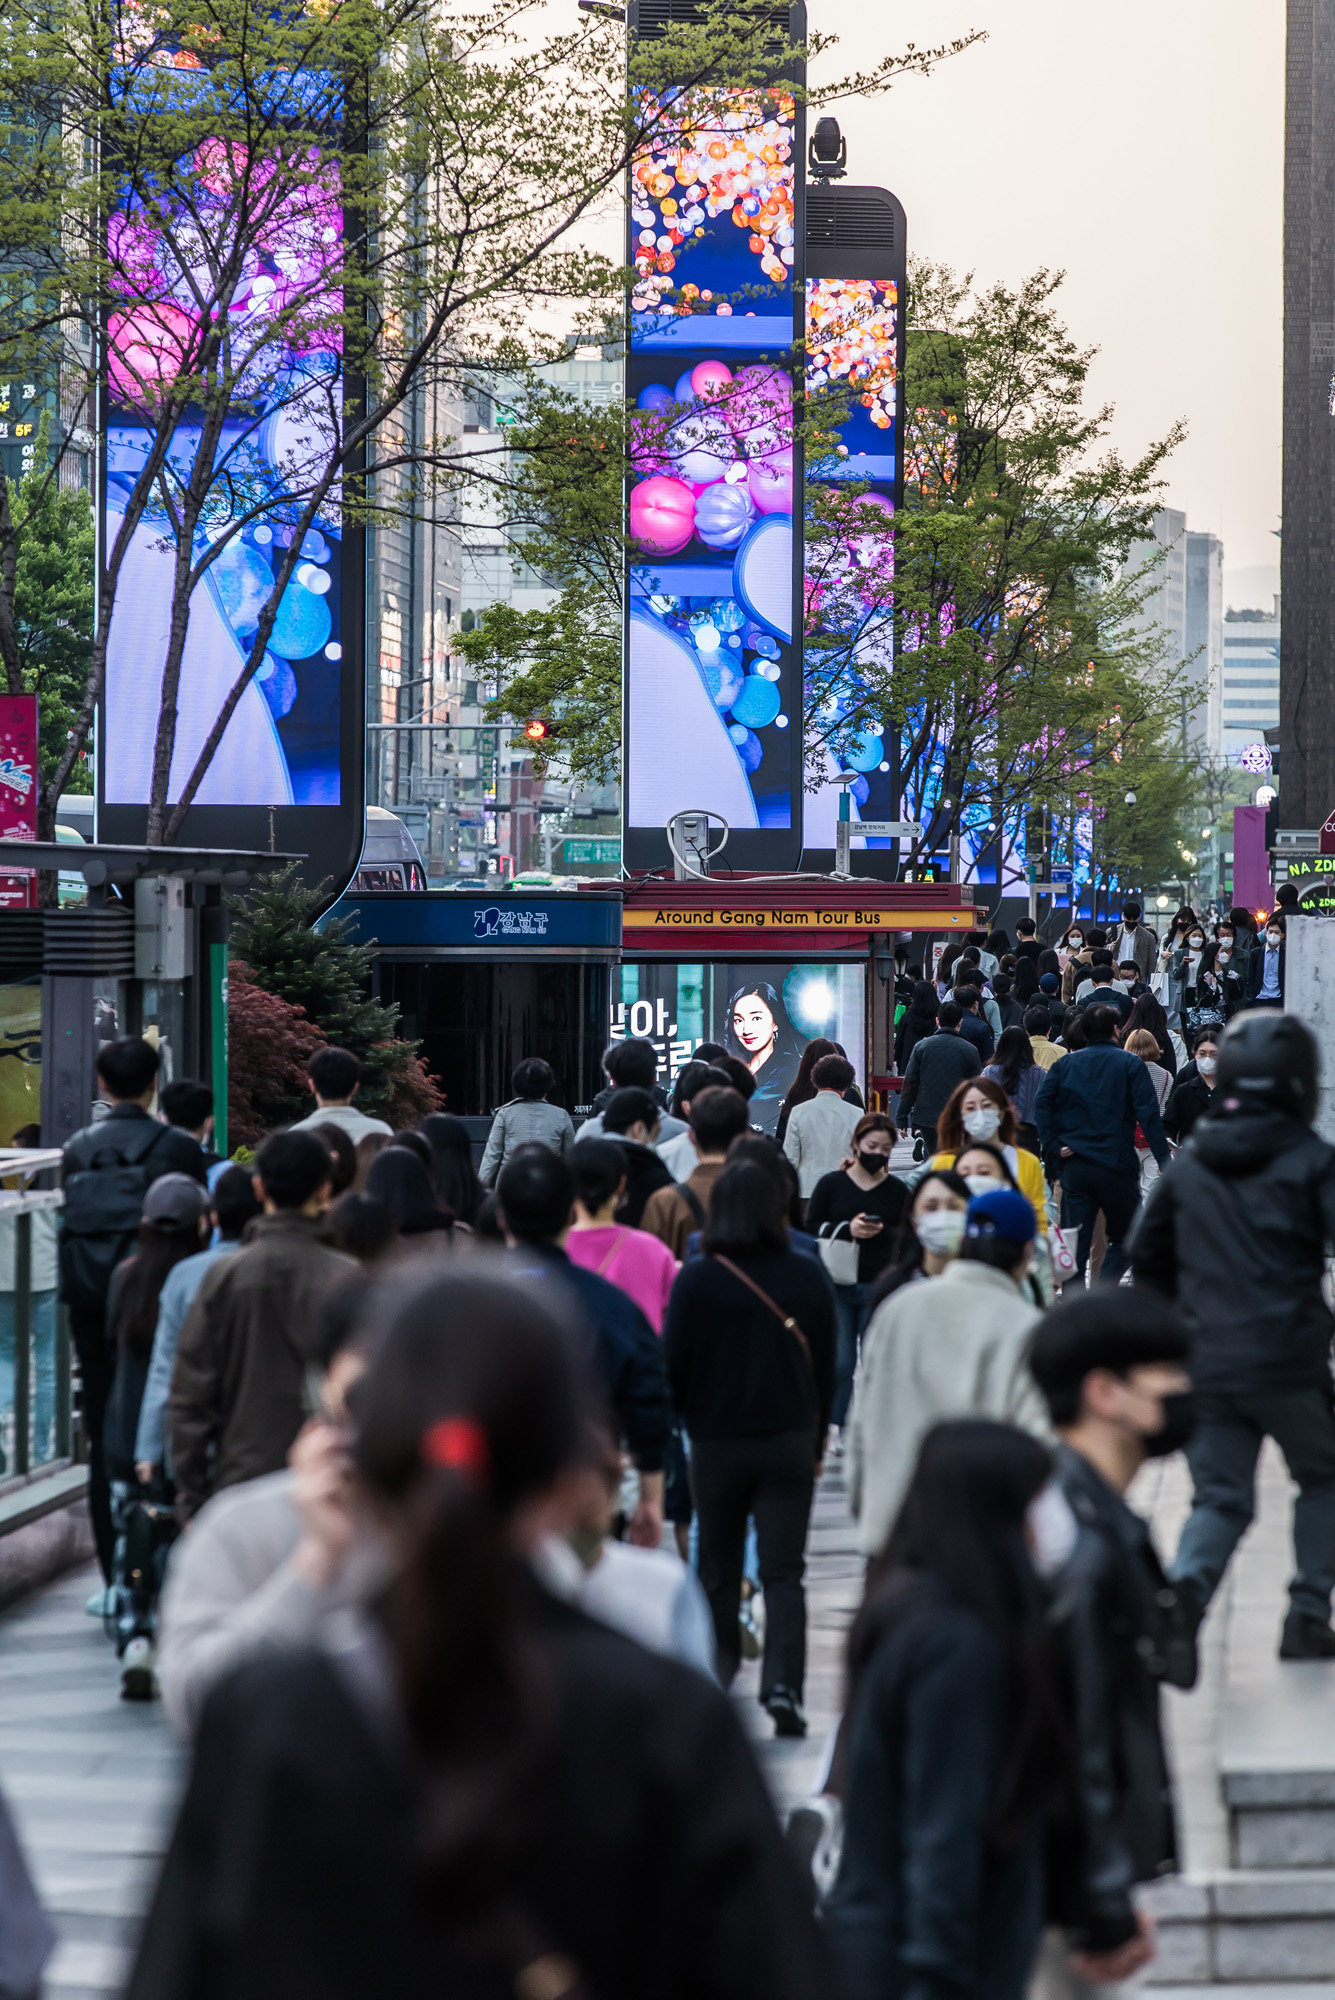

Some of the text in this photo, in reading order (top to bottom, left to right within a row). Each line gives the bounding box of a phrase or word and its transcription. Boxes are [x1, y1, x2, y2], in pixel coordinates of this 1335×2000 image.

[15, 424, 32, 437] 5F
[0, 773, 28, 792] OREA
[1289, 861, 1311, 877] NA
[499, 911, 549, 928] 강남구
[655, 910, 881, 926] Around Gang Nam Tour Bus
